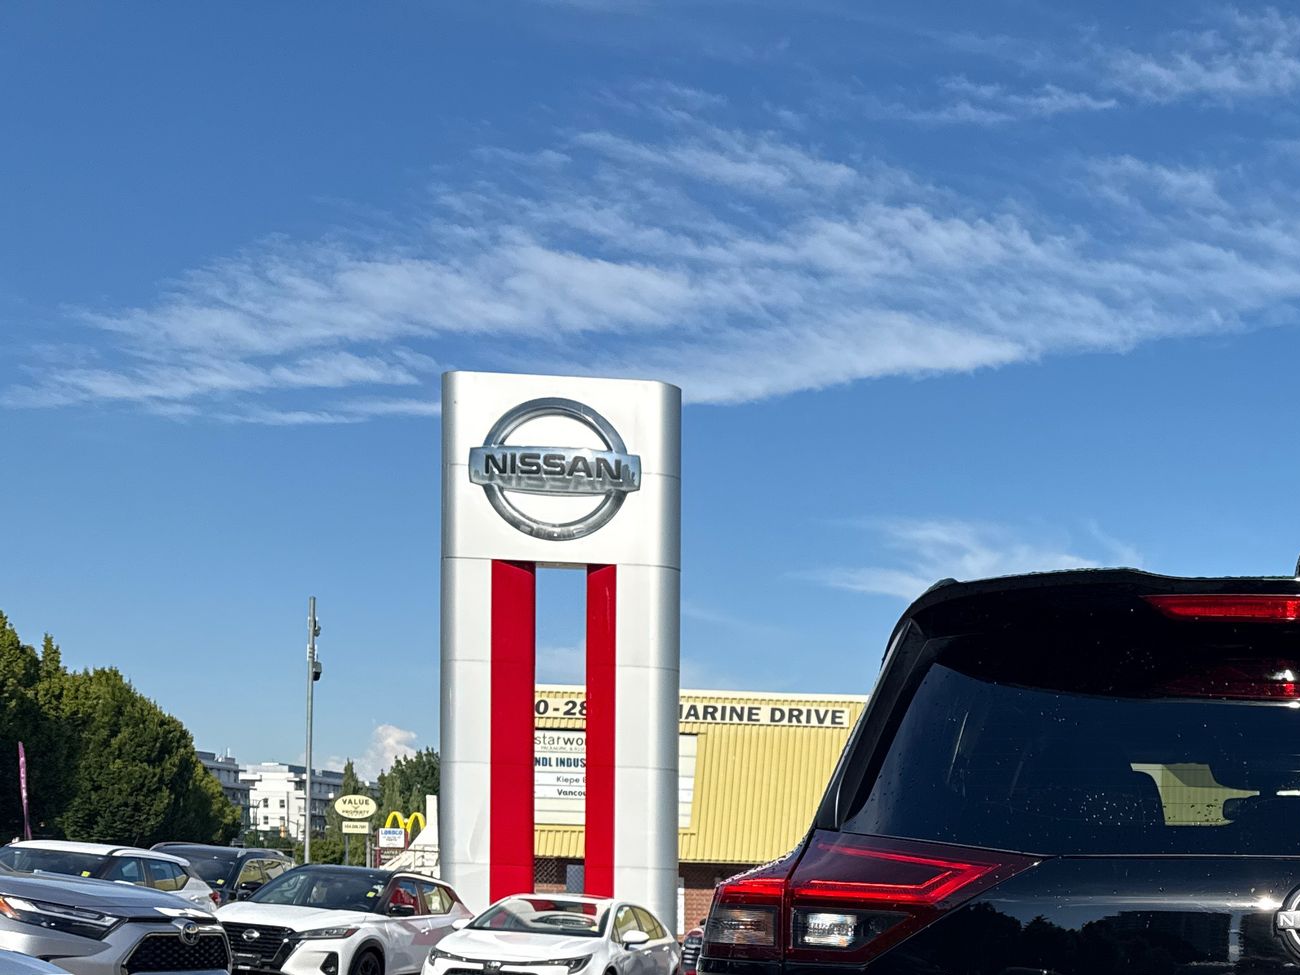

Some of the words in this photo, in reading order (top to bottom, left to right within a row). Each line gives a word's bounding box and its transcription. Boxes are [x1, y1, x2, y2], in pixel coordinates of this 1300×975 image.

[484, 452, 622, 480] NISSAN
[679, 703, 762, 723] ARINE
[769, 707, 845, 726] DRIVE
[535, 732, 587, 746] starwo
[341, 798, 370, 806] VALUE
